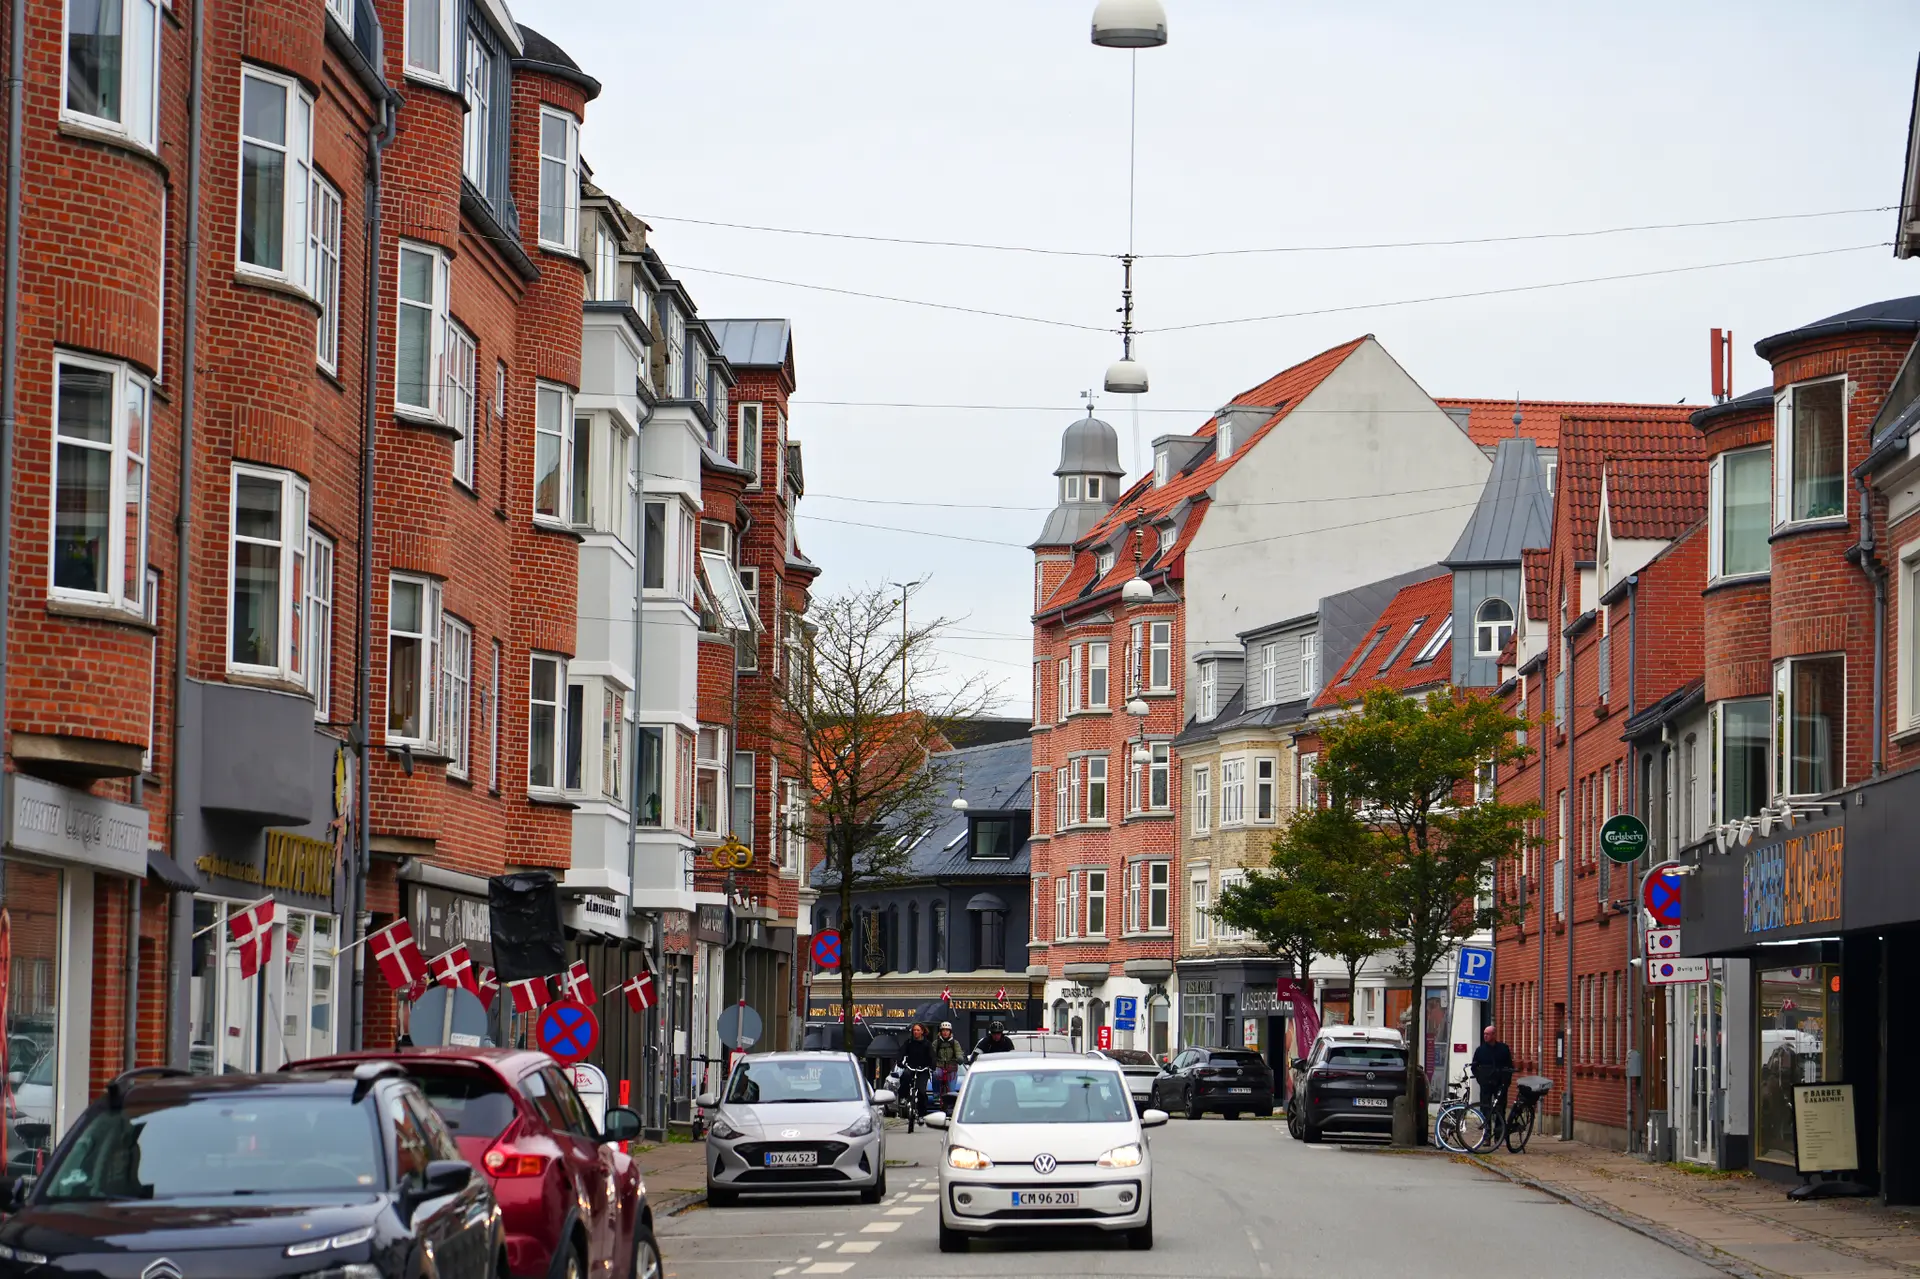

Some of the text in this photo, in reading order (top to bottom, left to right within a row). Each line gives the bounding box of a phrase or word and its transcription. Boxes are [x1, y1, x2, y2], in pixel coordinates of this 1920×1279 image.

[1605, 830, 1644, 845] Carlsberg
[1464, 952, 1486, 976] P
[948, 999, 1026, 1010] FREDERIKSBERG
[1119, 1000, 1132, 1016] P
[1810, 1089, 1842, 1097] BARBER
[1809, 1096, 1845, 1104] AKADEMIET
[771, 1153, 816, 1163] DX 44 523
[1020, 1193, 1075, 1204] CM 96 201
